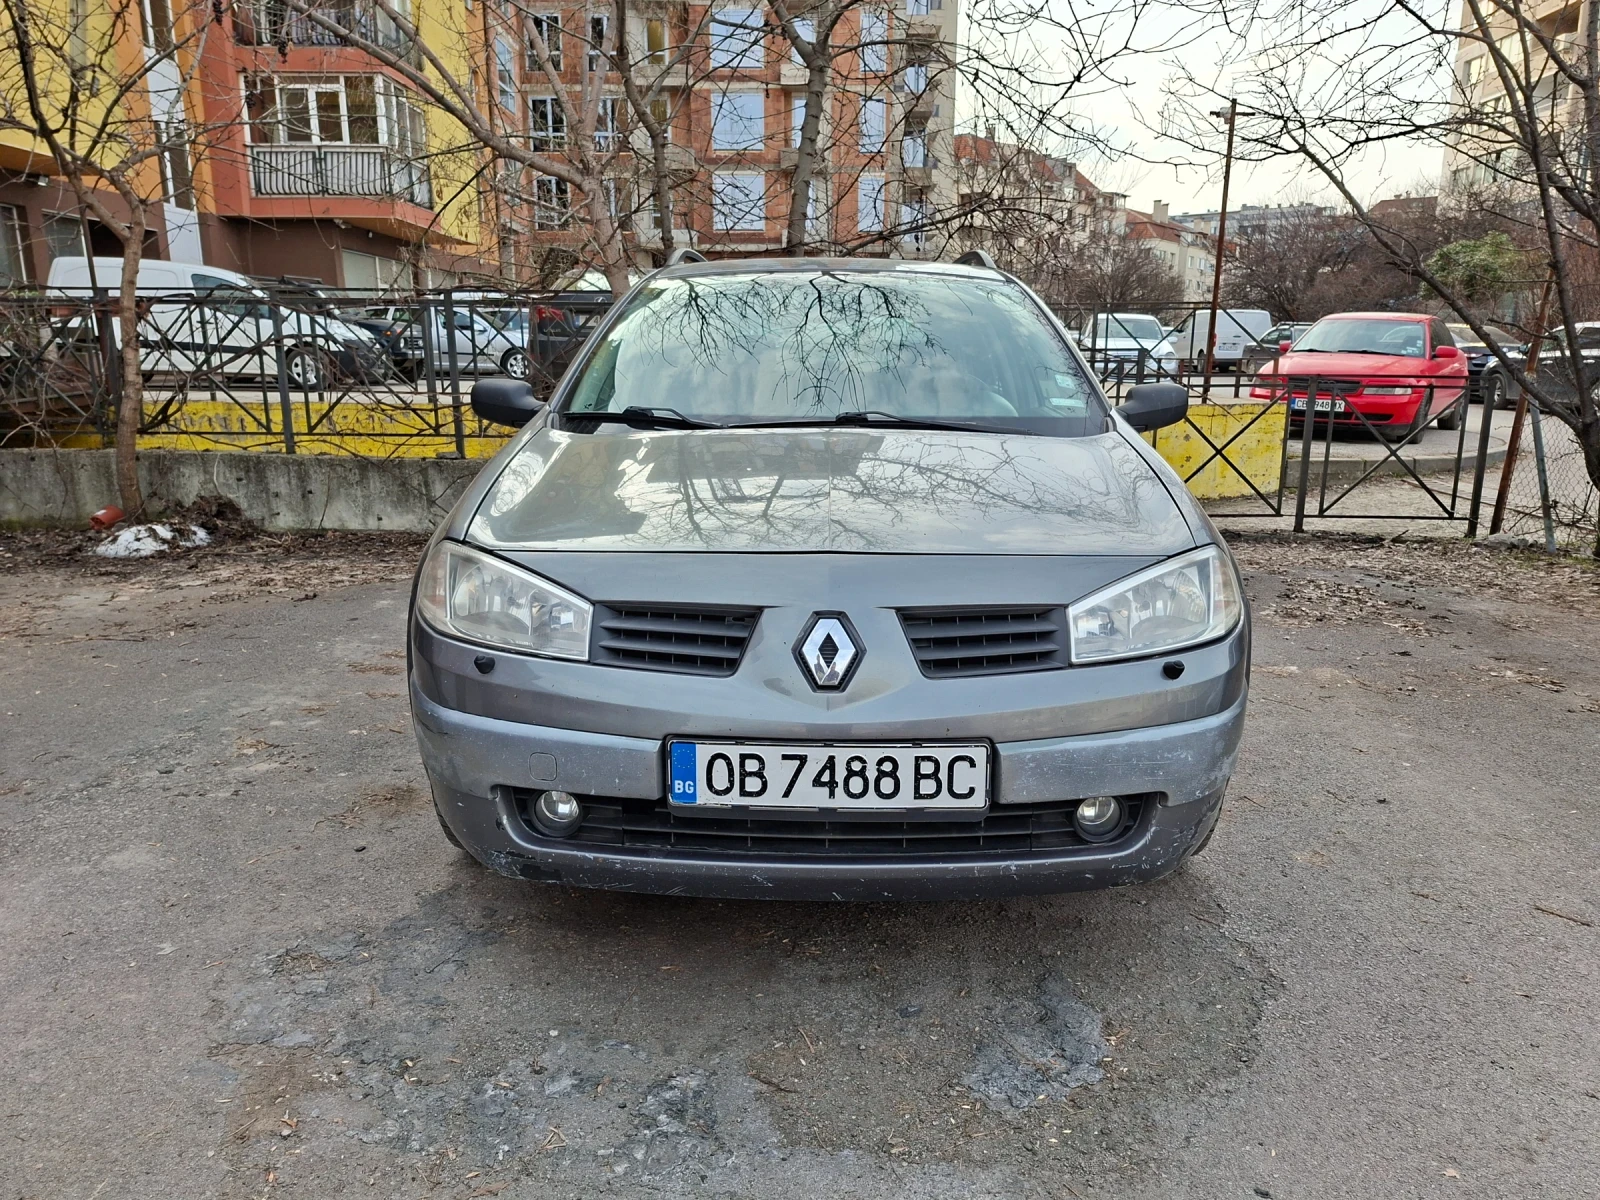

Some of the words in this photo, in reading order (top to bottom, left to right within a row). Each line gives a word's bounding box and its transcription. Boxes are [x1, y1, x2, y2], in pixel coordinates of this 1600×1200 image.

[674, 779, 694, 794] BG
[705, 752, 768, 798] OB
[781, 753, 901, 800] 7488
[913, 755, 977, 801] BC
